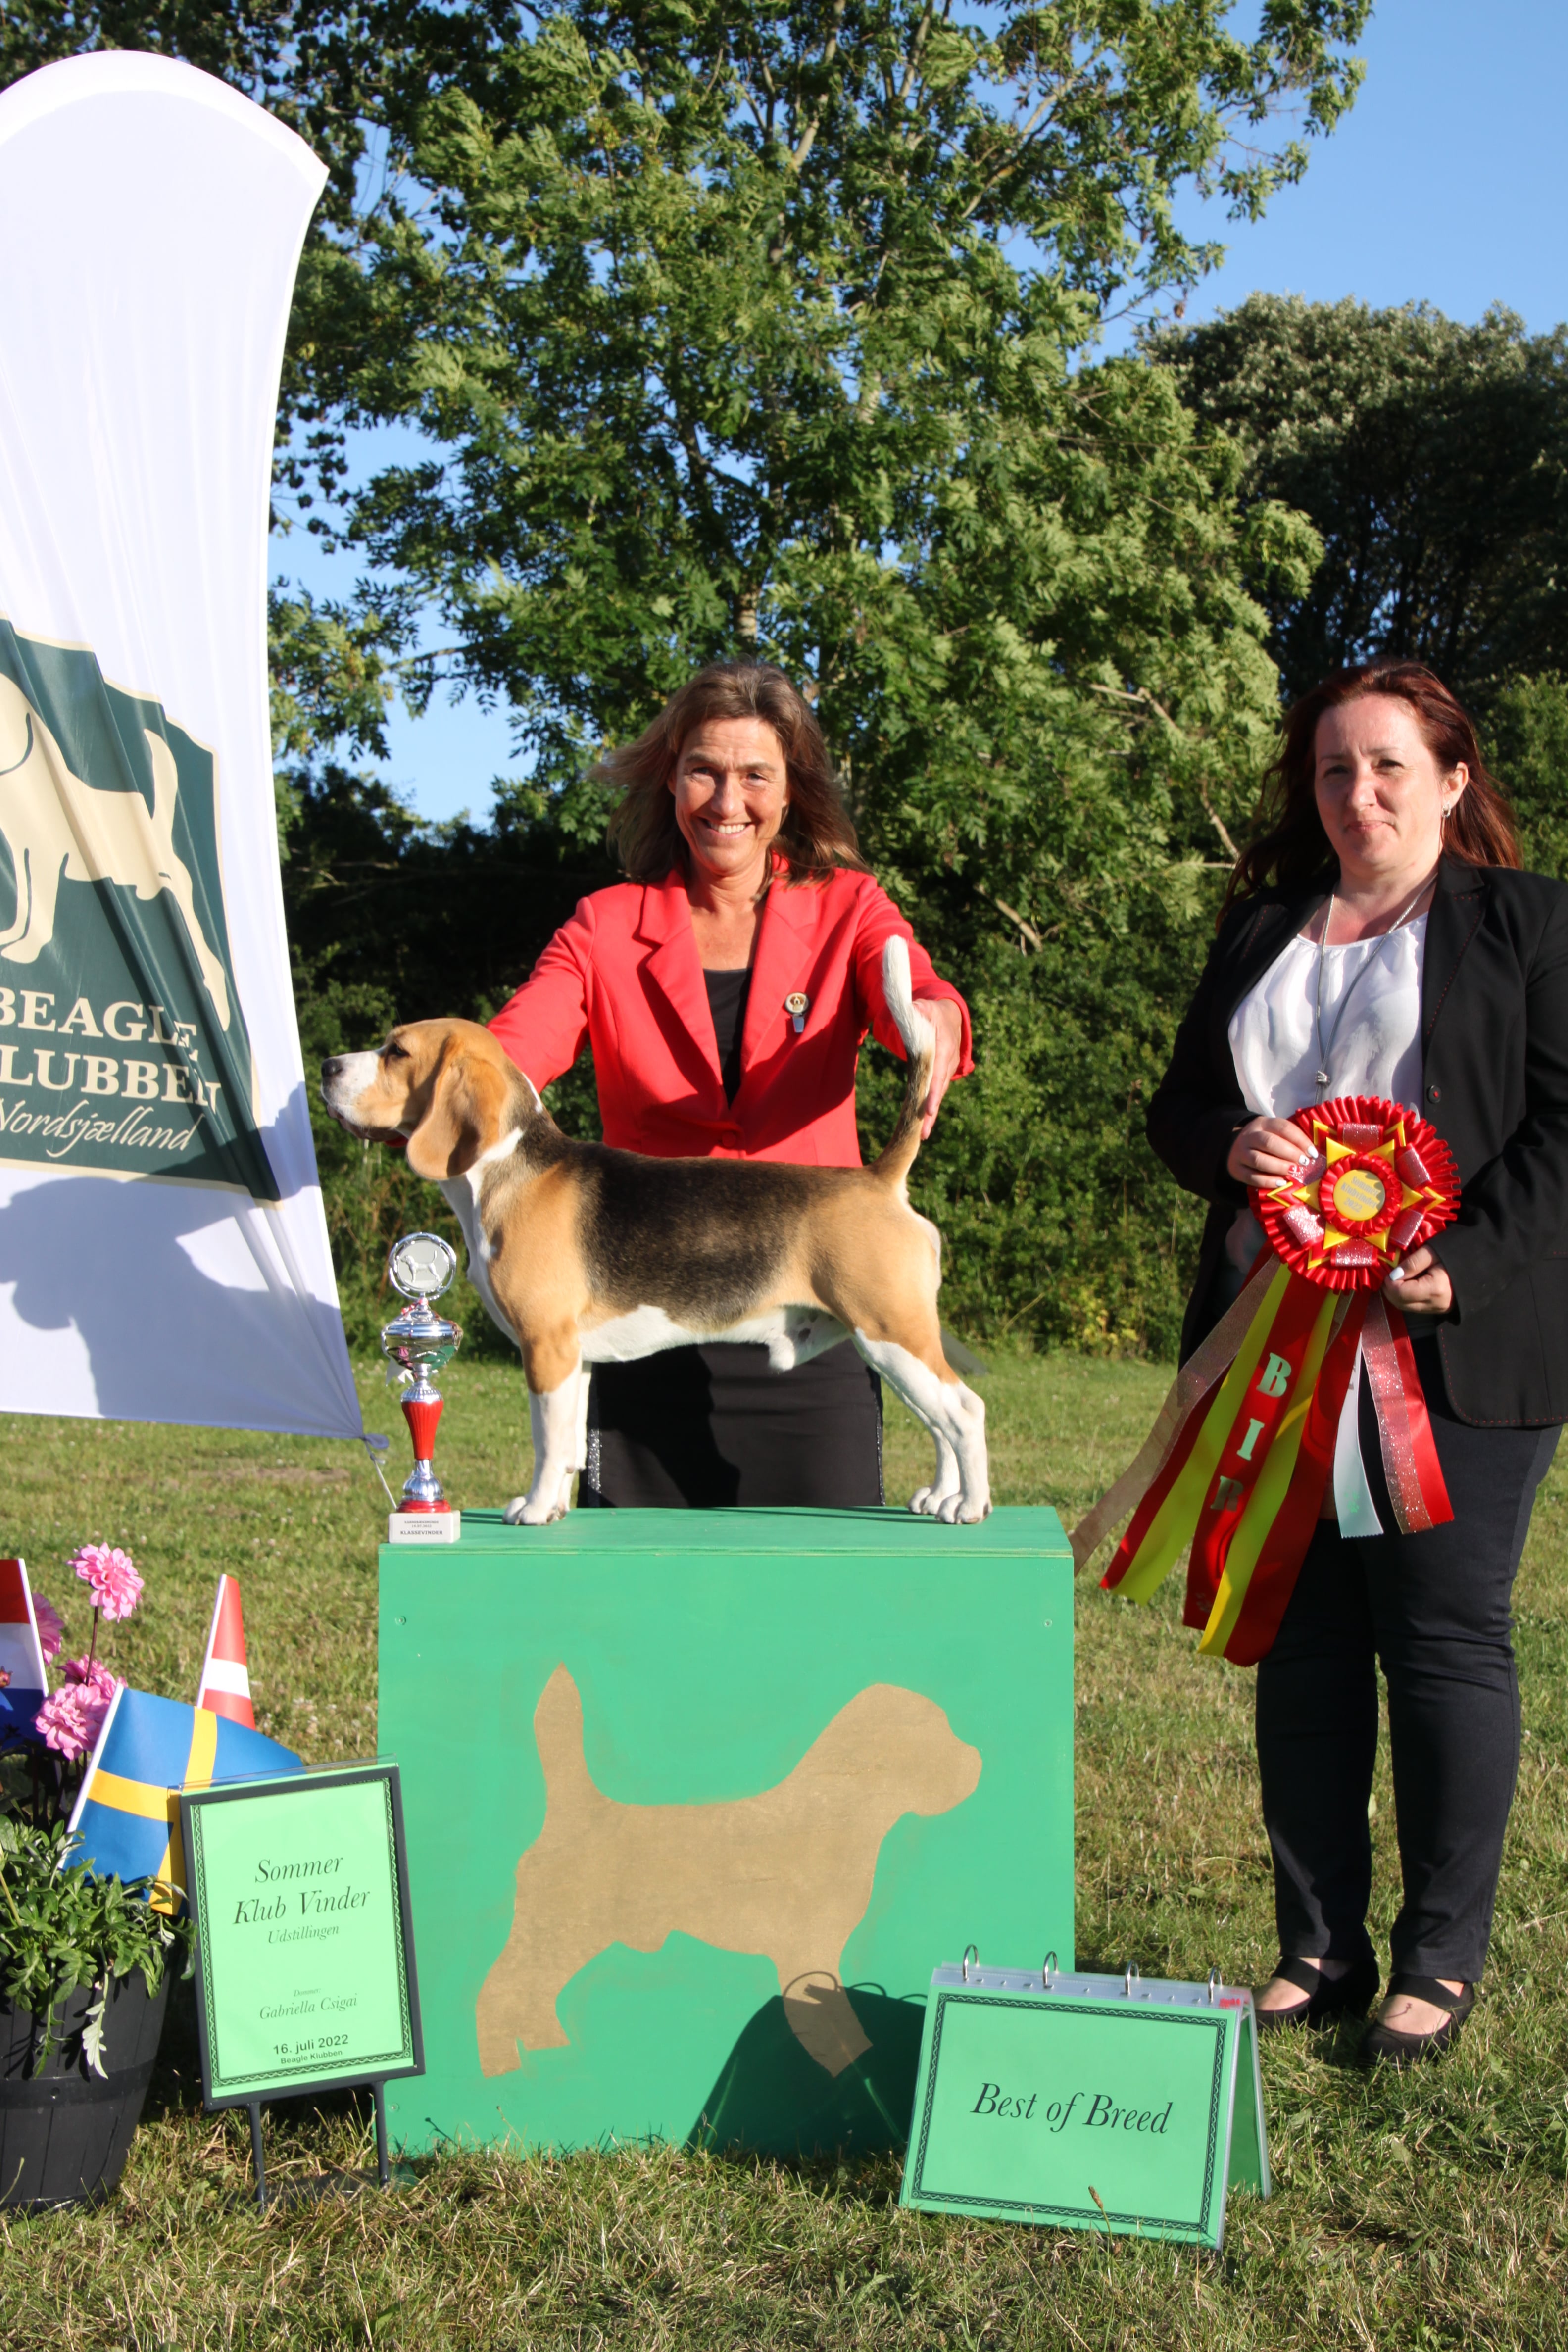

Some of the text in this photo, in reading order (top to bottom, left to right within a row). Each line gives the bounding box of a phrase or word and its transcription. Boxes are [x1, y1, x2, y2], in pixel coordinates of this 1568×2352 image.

[255, 1857, 343, 1883] Sommer
[233, 1886, 370, 1924] Klub Vinder
[268, 1925, 339, 1944] Udstillingen
[260, 1993, 357, 2019] Gabriella Csigai
[273, 2034, 348, 2055] 16. juli 2022
[281, 2050, 343, 2064] Beagle Klubben
[970, 2083, 1173, 2134] Best of Breed
